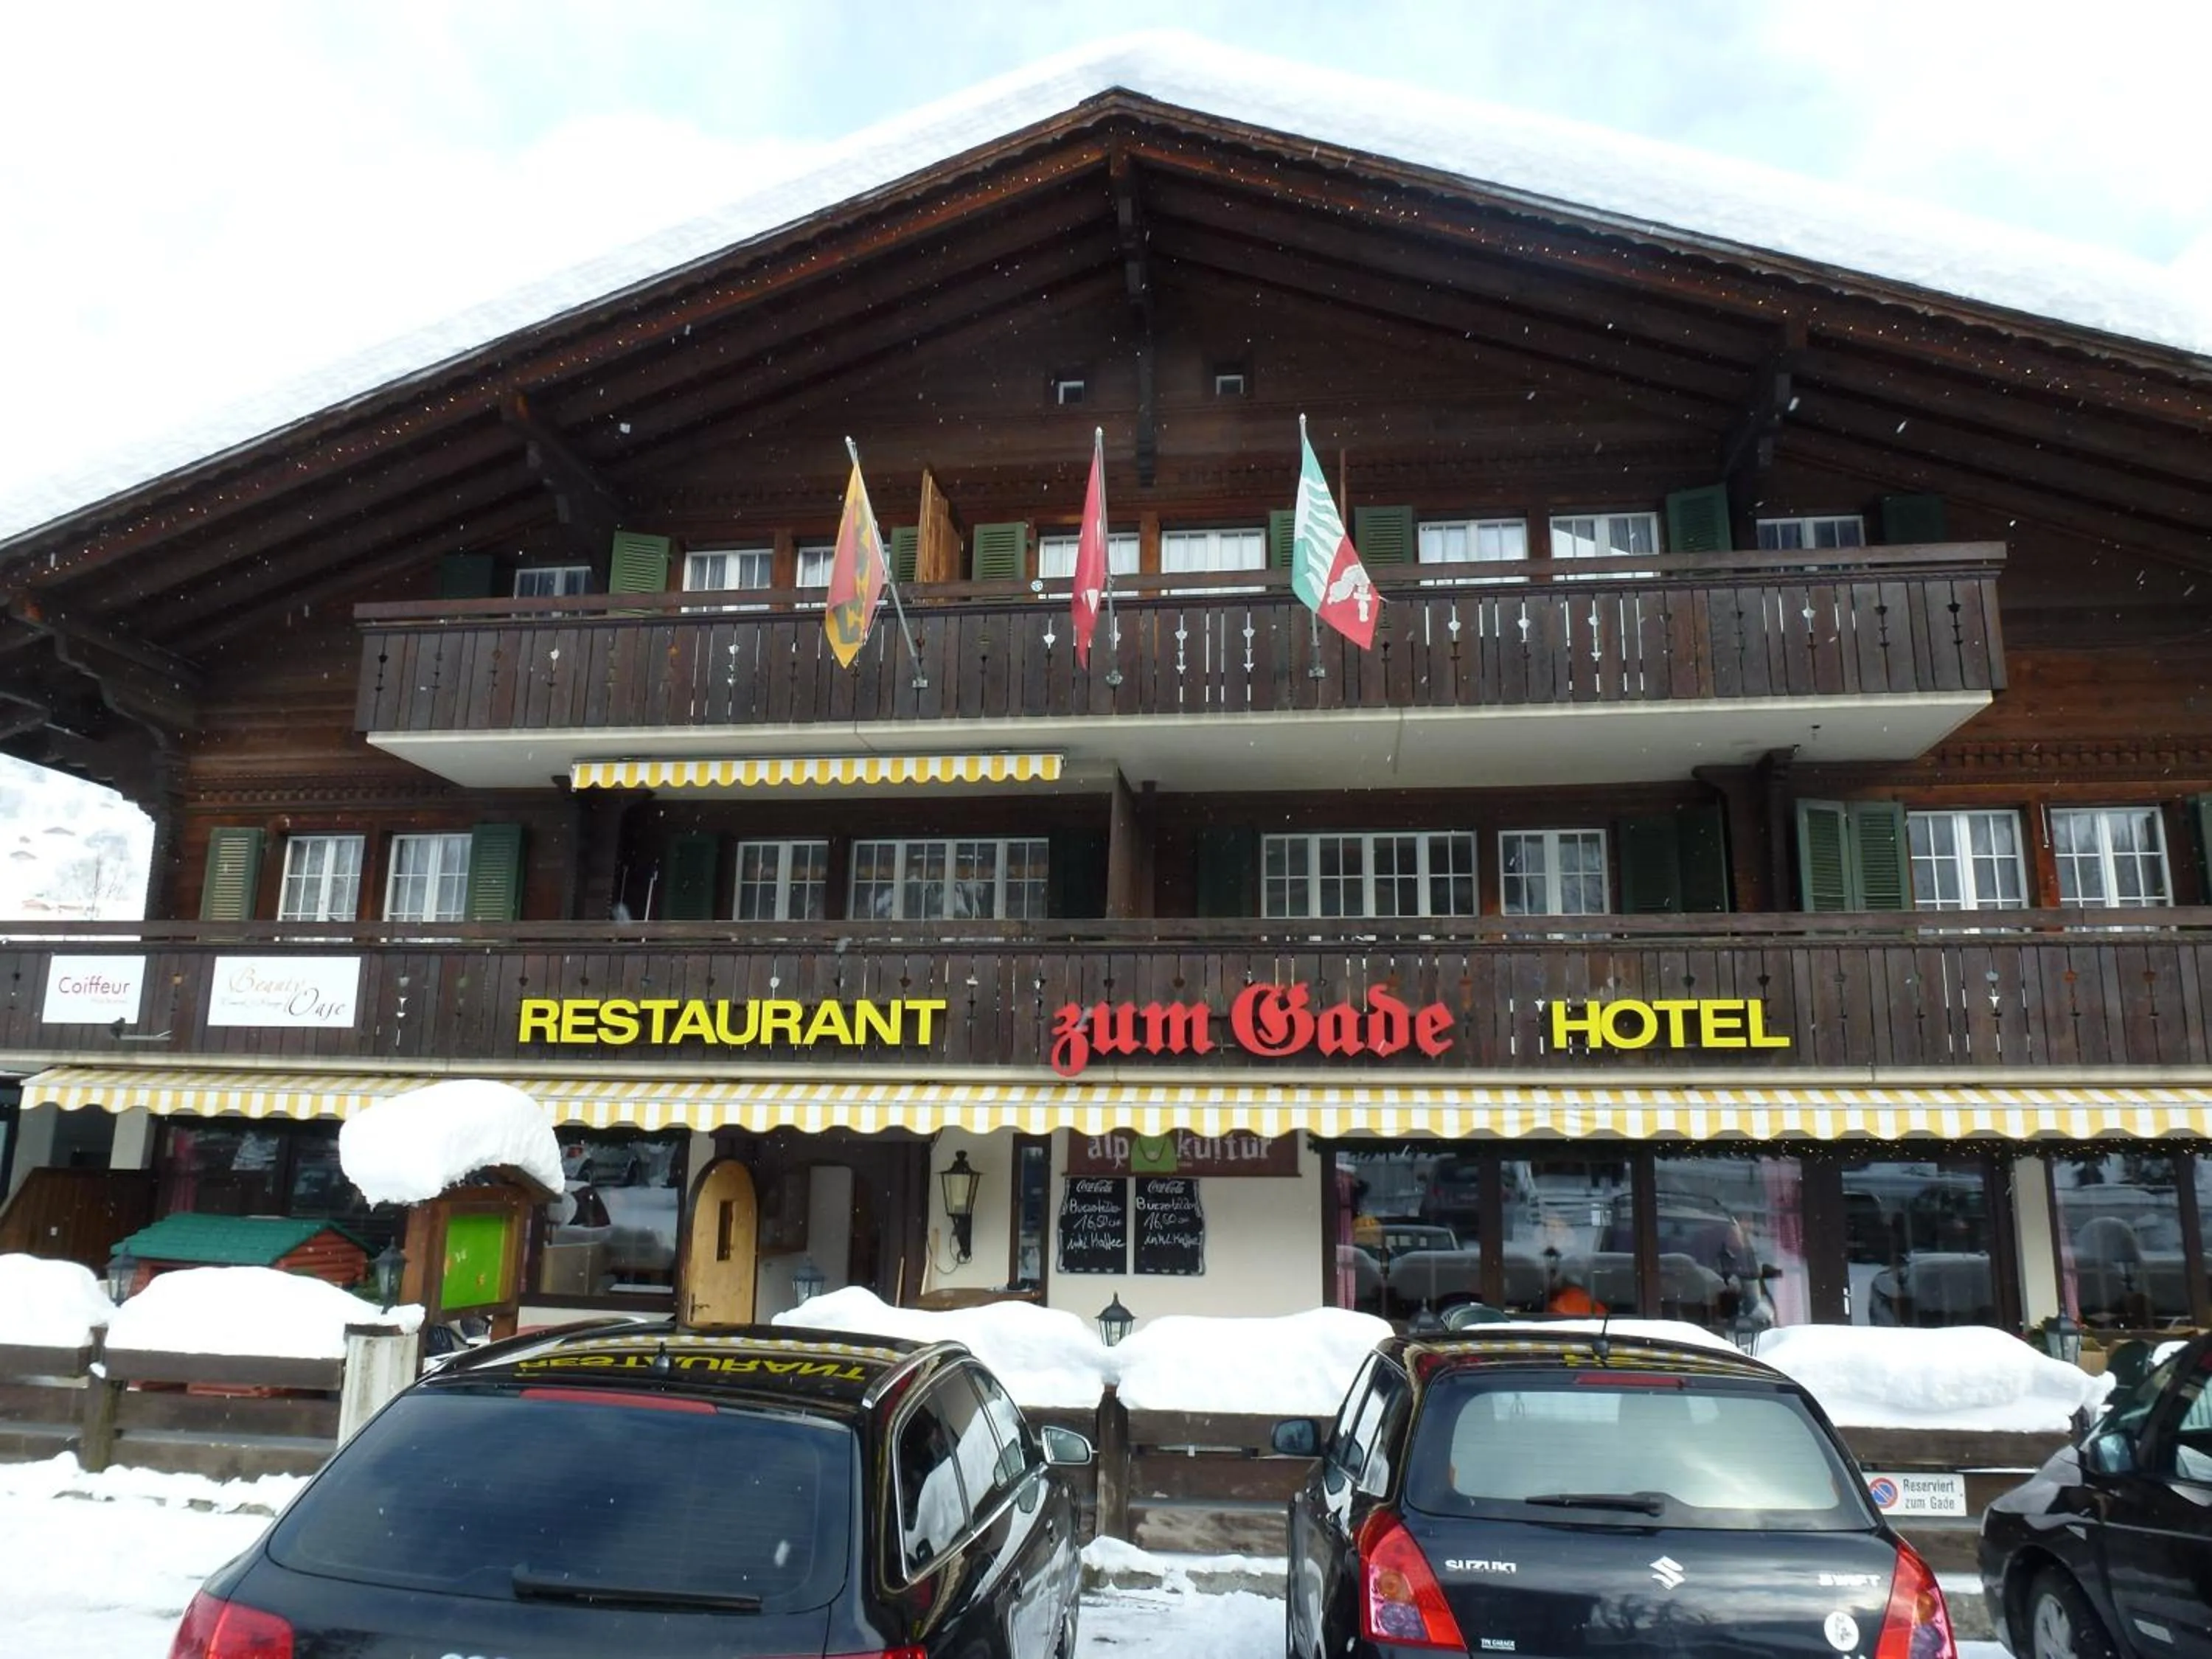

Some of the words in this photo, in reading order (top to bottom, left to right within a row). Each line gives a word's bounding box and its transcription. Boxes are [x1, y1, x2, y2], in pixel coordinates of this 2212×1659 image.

[58, 975, 131, 995] Coiffeur
[518, 999, 947, 1046] RESTAURANT
[1050, 1001, 1216, 1077] zum
[1231, 981, 1455, 1059] Gade
[1551, 998, 1790, 1049] HOTEL
[1903, 1478, 1955, 1493] Reserviert
[1905, 1498, 1926, 1509] zum
[1930, 1496, 1955, 1509] Gade
[1445, 1559, 1517, 1574] SUZUKI
